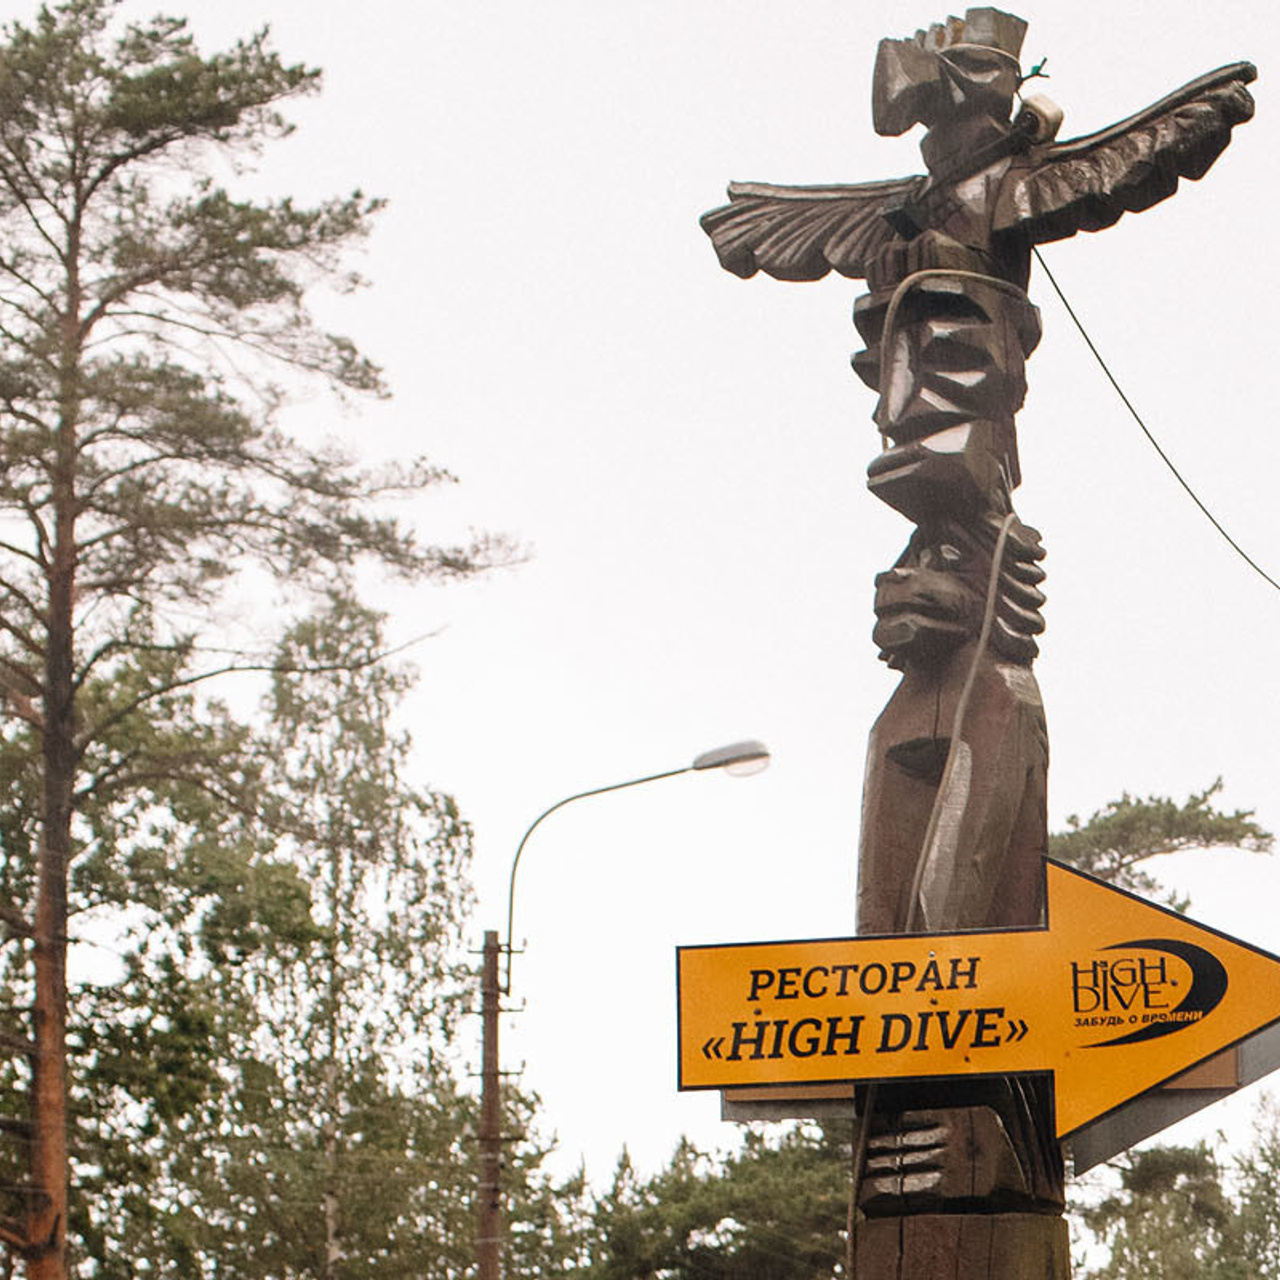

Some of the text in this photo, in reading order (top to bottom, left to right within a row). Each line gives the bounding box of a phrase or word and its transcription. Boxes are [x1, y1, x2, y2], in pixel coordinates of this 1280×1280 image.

[747, 957, 981, 1001] РЕСТОРАН
[1072, 983, 1169, 1013] DIVE
[701, 1007, 1030, 1061] «HIGH DIVE»
[1074, 1015, 1124, 1027] ЗАБУДЬ
[1128, 1014, 1138, 1024] О
